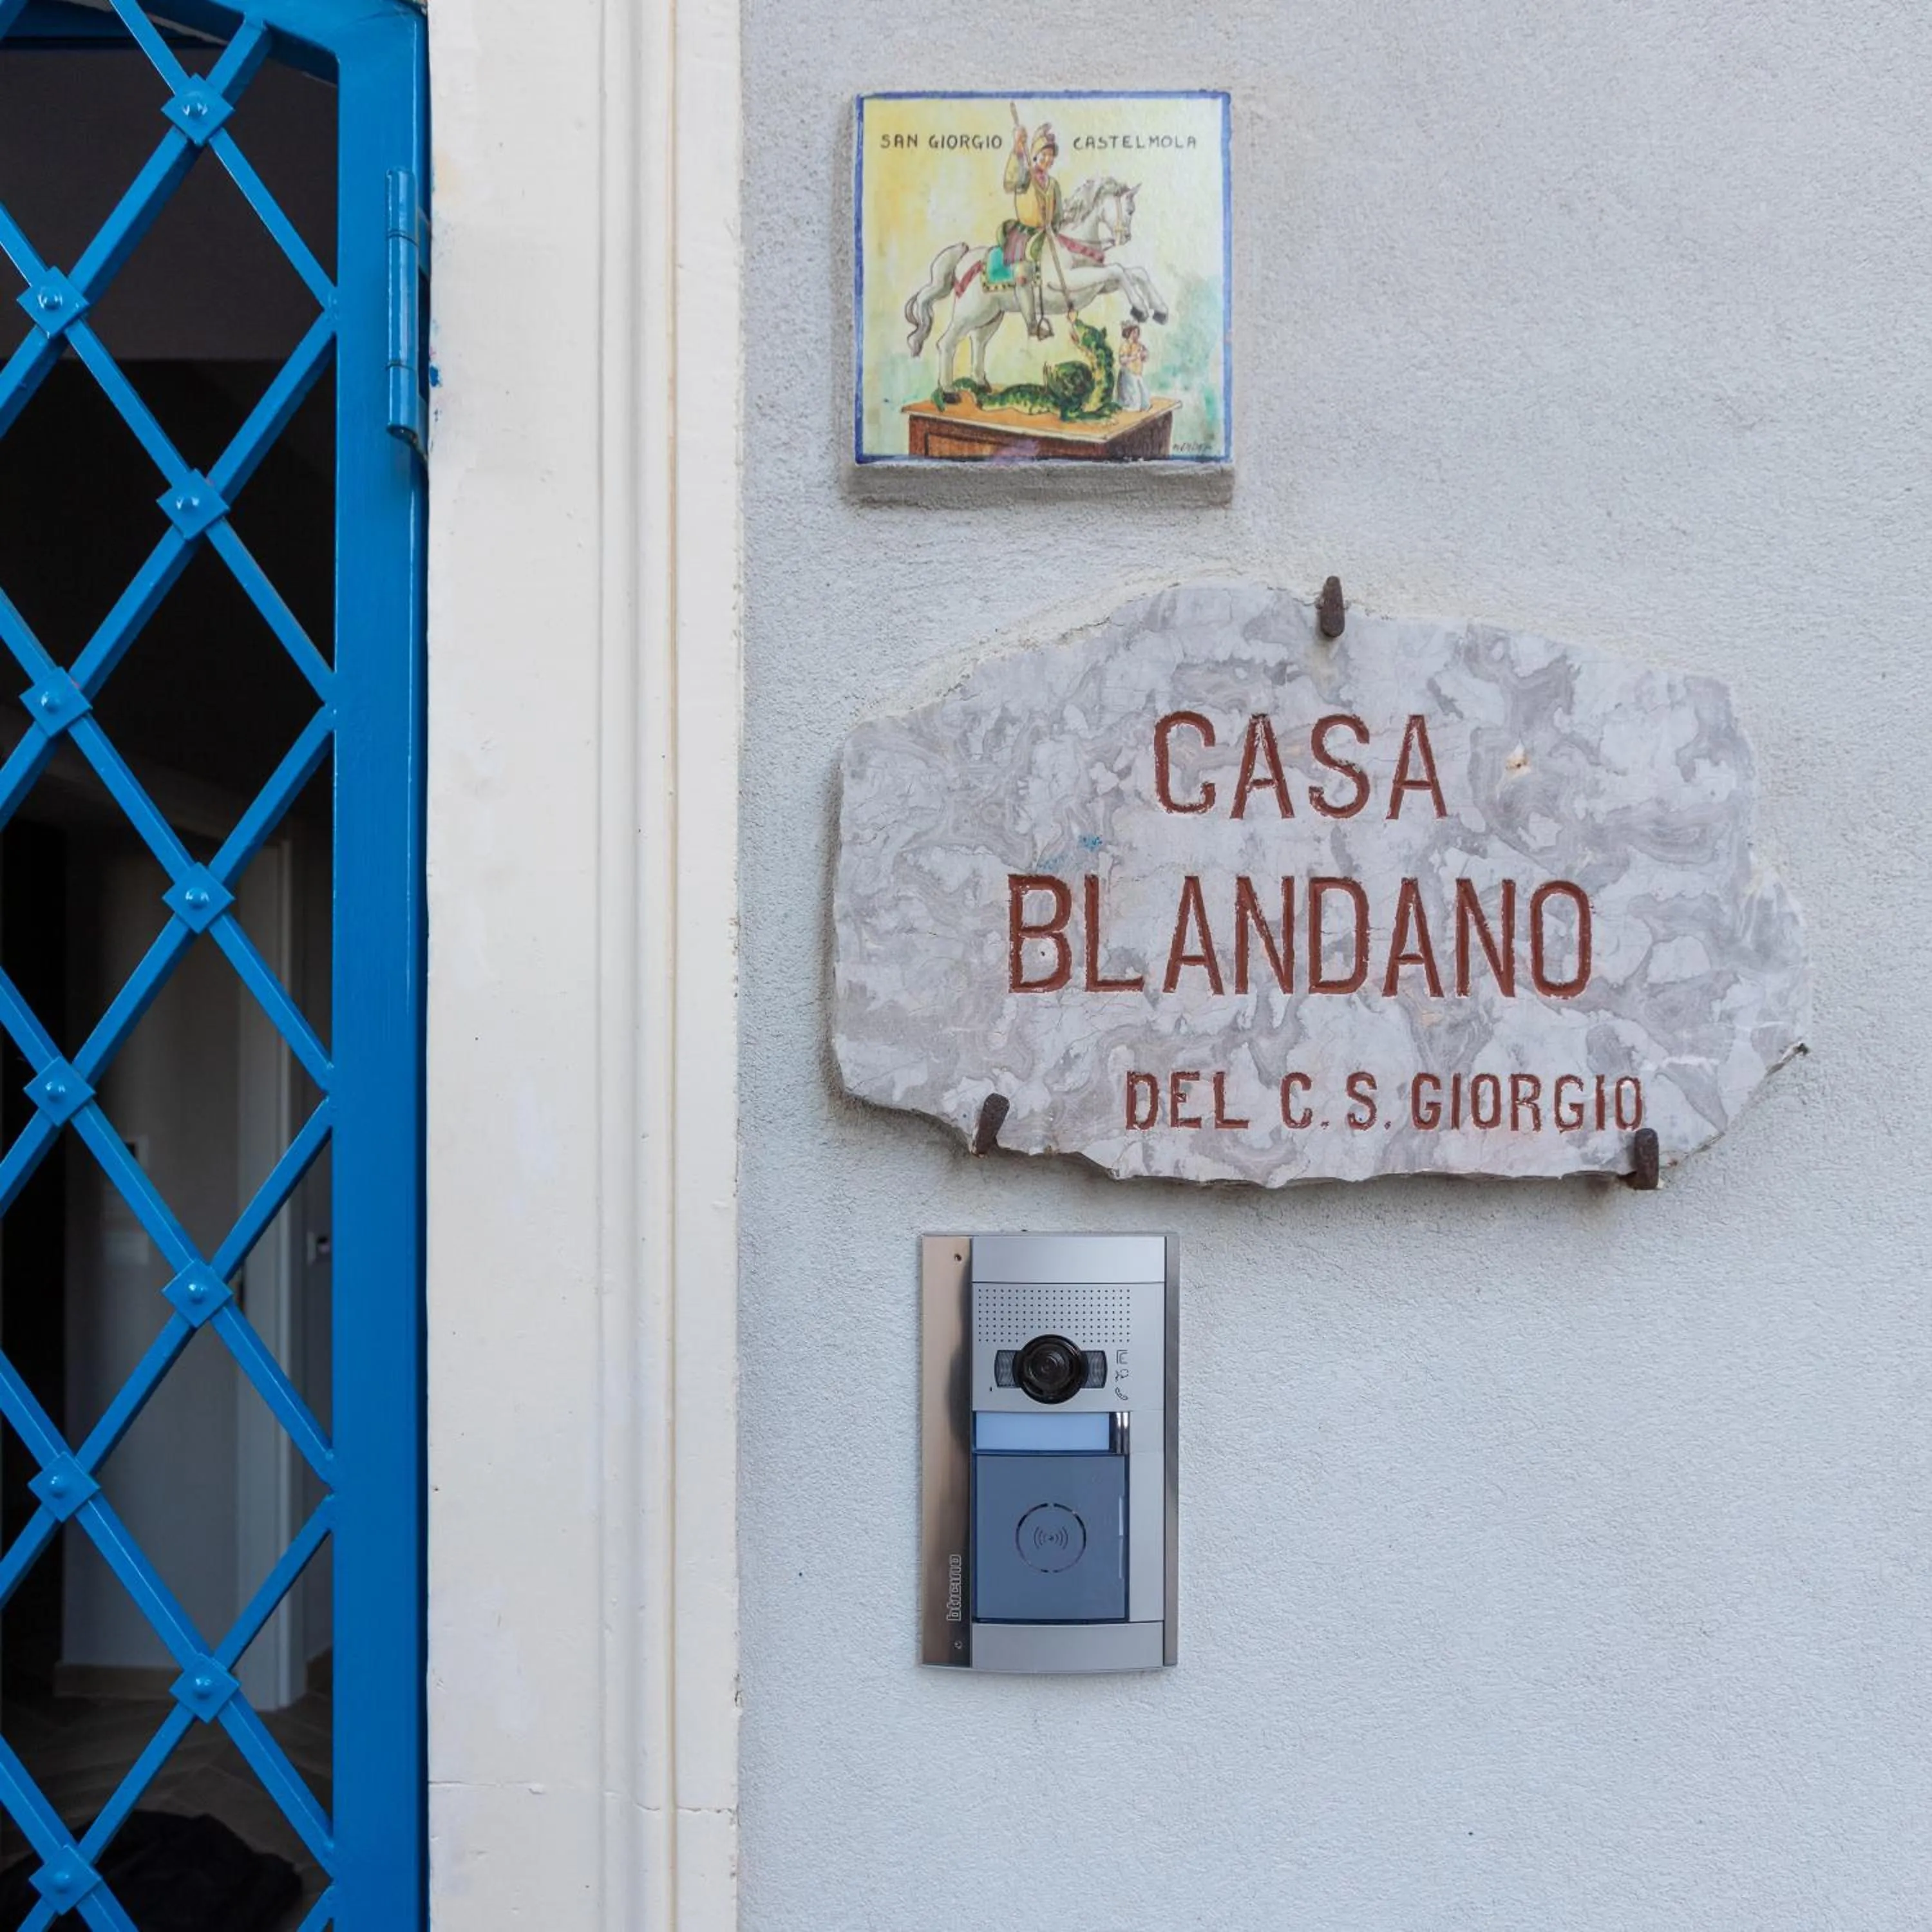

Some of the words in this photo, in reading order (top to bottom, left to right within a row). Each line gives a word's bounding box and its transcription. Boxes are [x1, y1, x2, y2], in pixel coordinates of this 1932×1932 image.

[880, 134, 918, 148] SAN
[928, 133, 1003, 150] GIORGIO
[1073, 134, 1197, 150] CASTELMOLA
[1155, 712, 1446, 819] CASA
[1009, 875, 1591, 997] BLANDANO
[1126, 1071, 1250, 1130] DEL
[1410, 1072, 1643, 1132] GIORGIO
